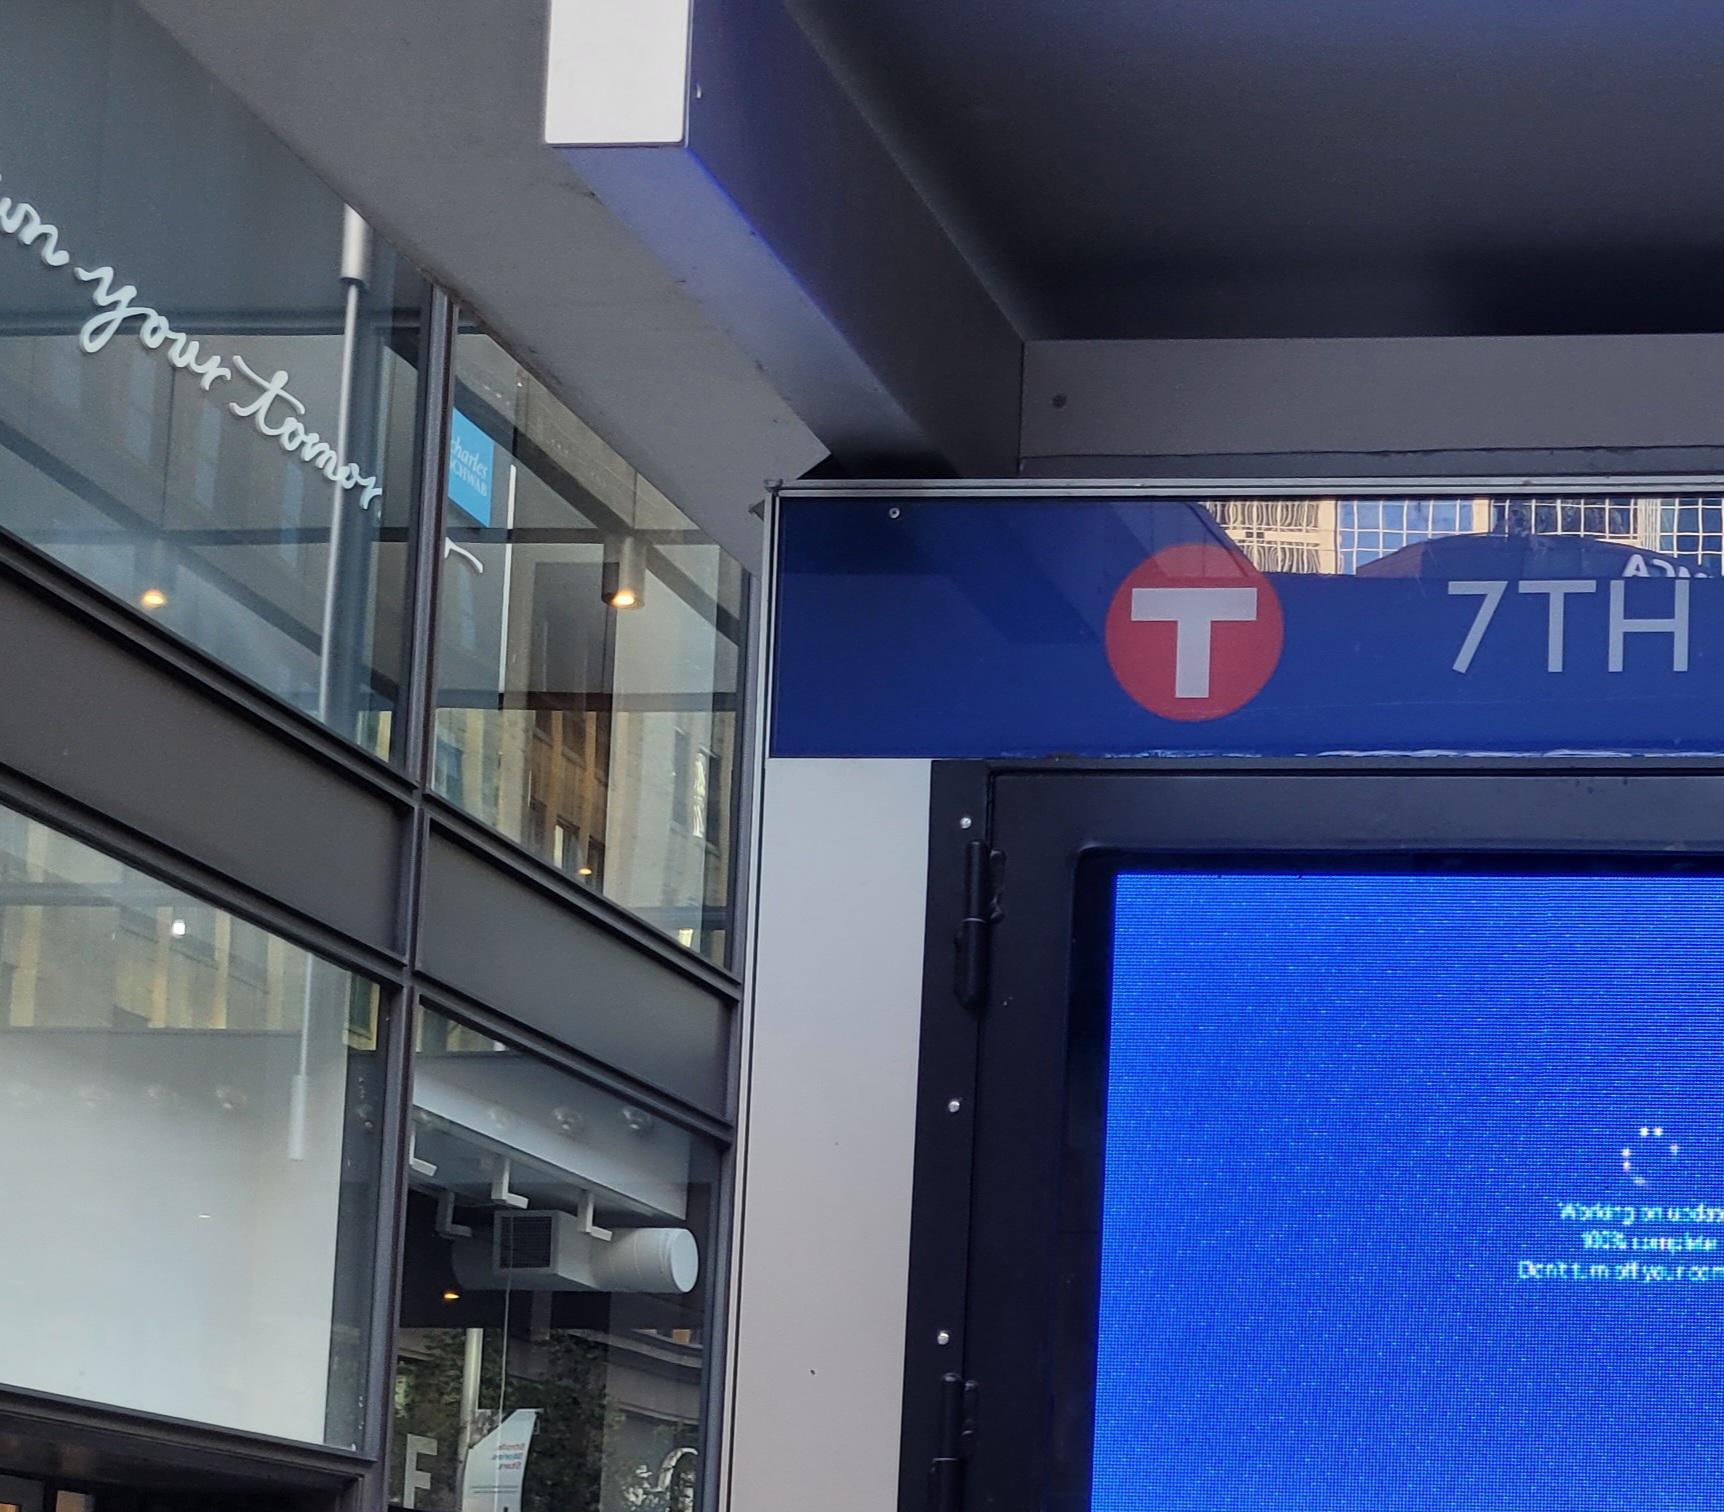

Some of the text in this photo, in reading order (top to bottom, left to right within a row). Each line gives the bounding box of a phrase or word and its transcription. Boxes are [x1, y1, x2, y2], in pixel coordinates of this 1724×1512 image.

[74, 265, 232, 391] your
[1131, 588, 1257, 698] T
[1448, 580, 1690, 674] 7TH
